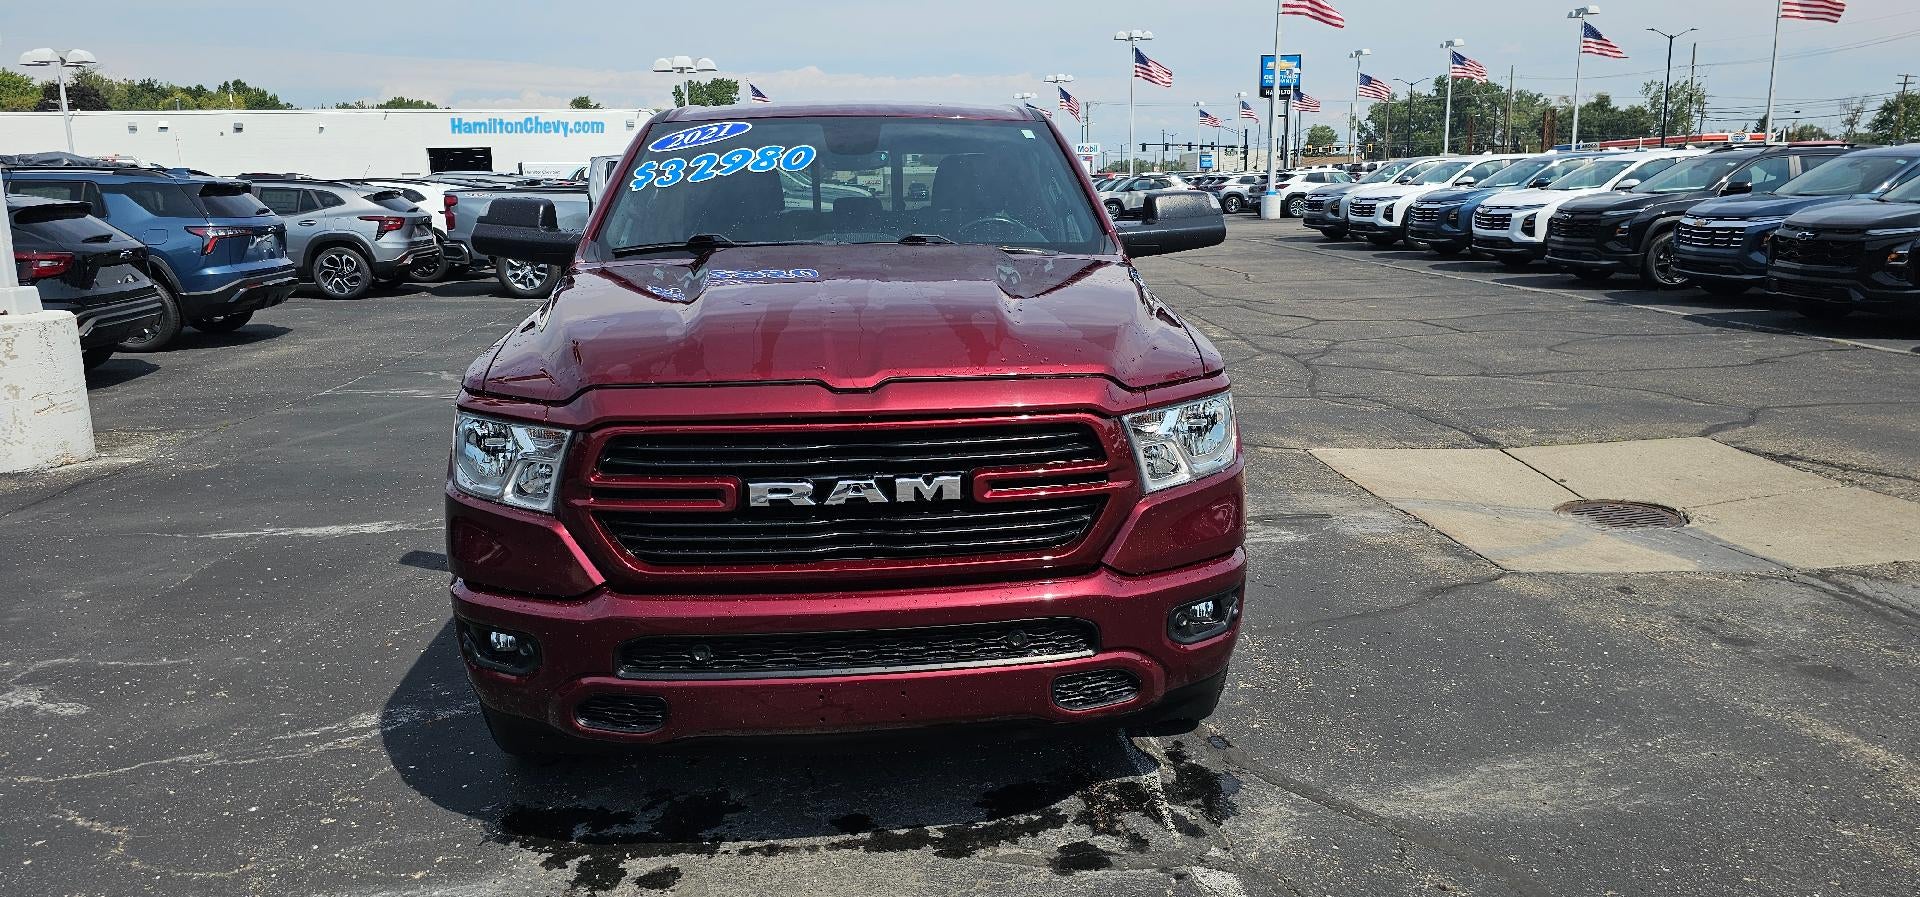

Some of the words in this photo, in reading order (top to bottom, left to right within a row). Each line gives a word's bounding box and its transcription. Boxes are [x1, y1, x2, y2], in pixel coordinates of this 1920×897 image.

[450, 116, 605, 137] HamiltonChevy.com
[666, 123, 733, 148] 2021
[1077, 145, 1098, 153] Mobil
[629, 145, 817, 191] $32980
[748, 475, 962, 507] RAM
